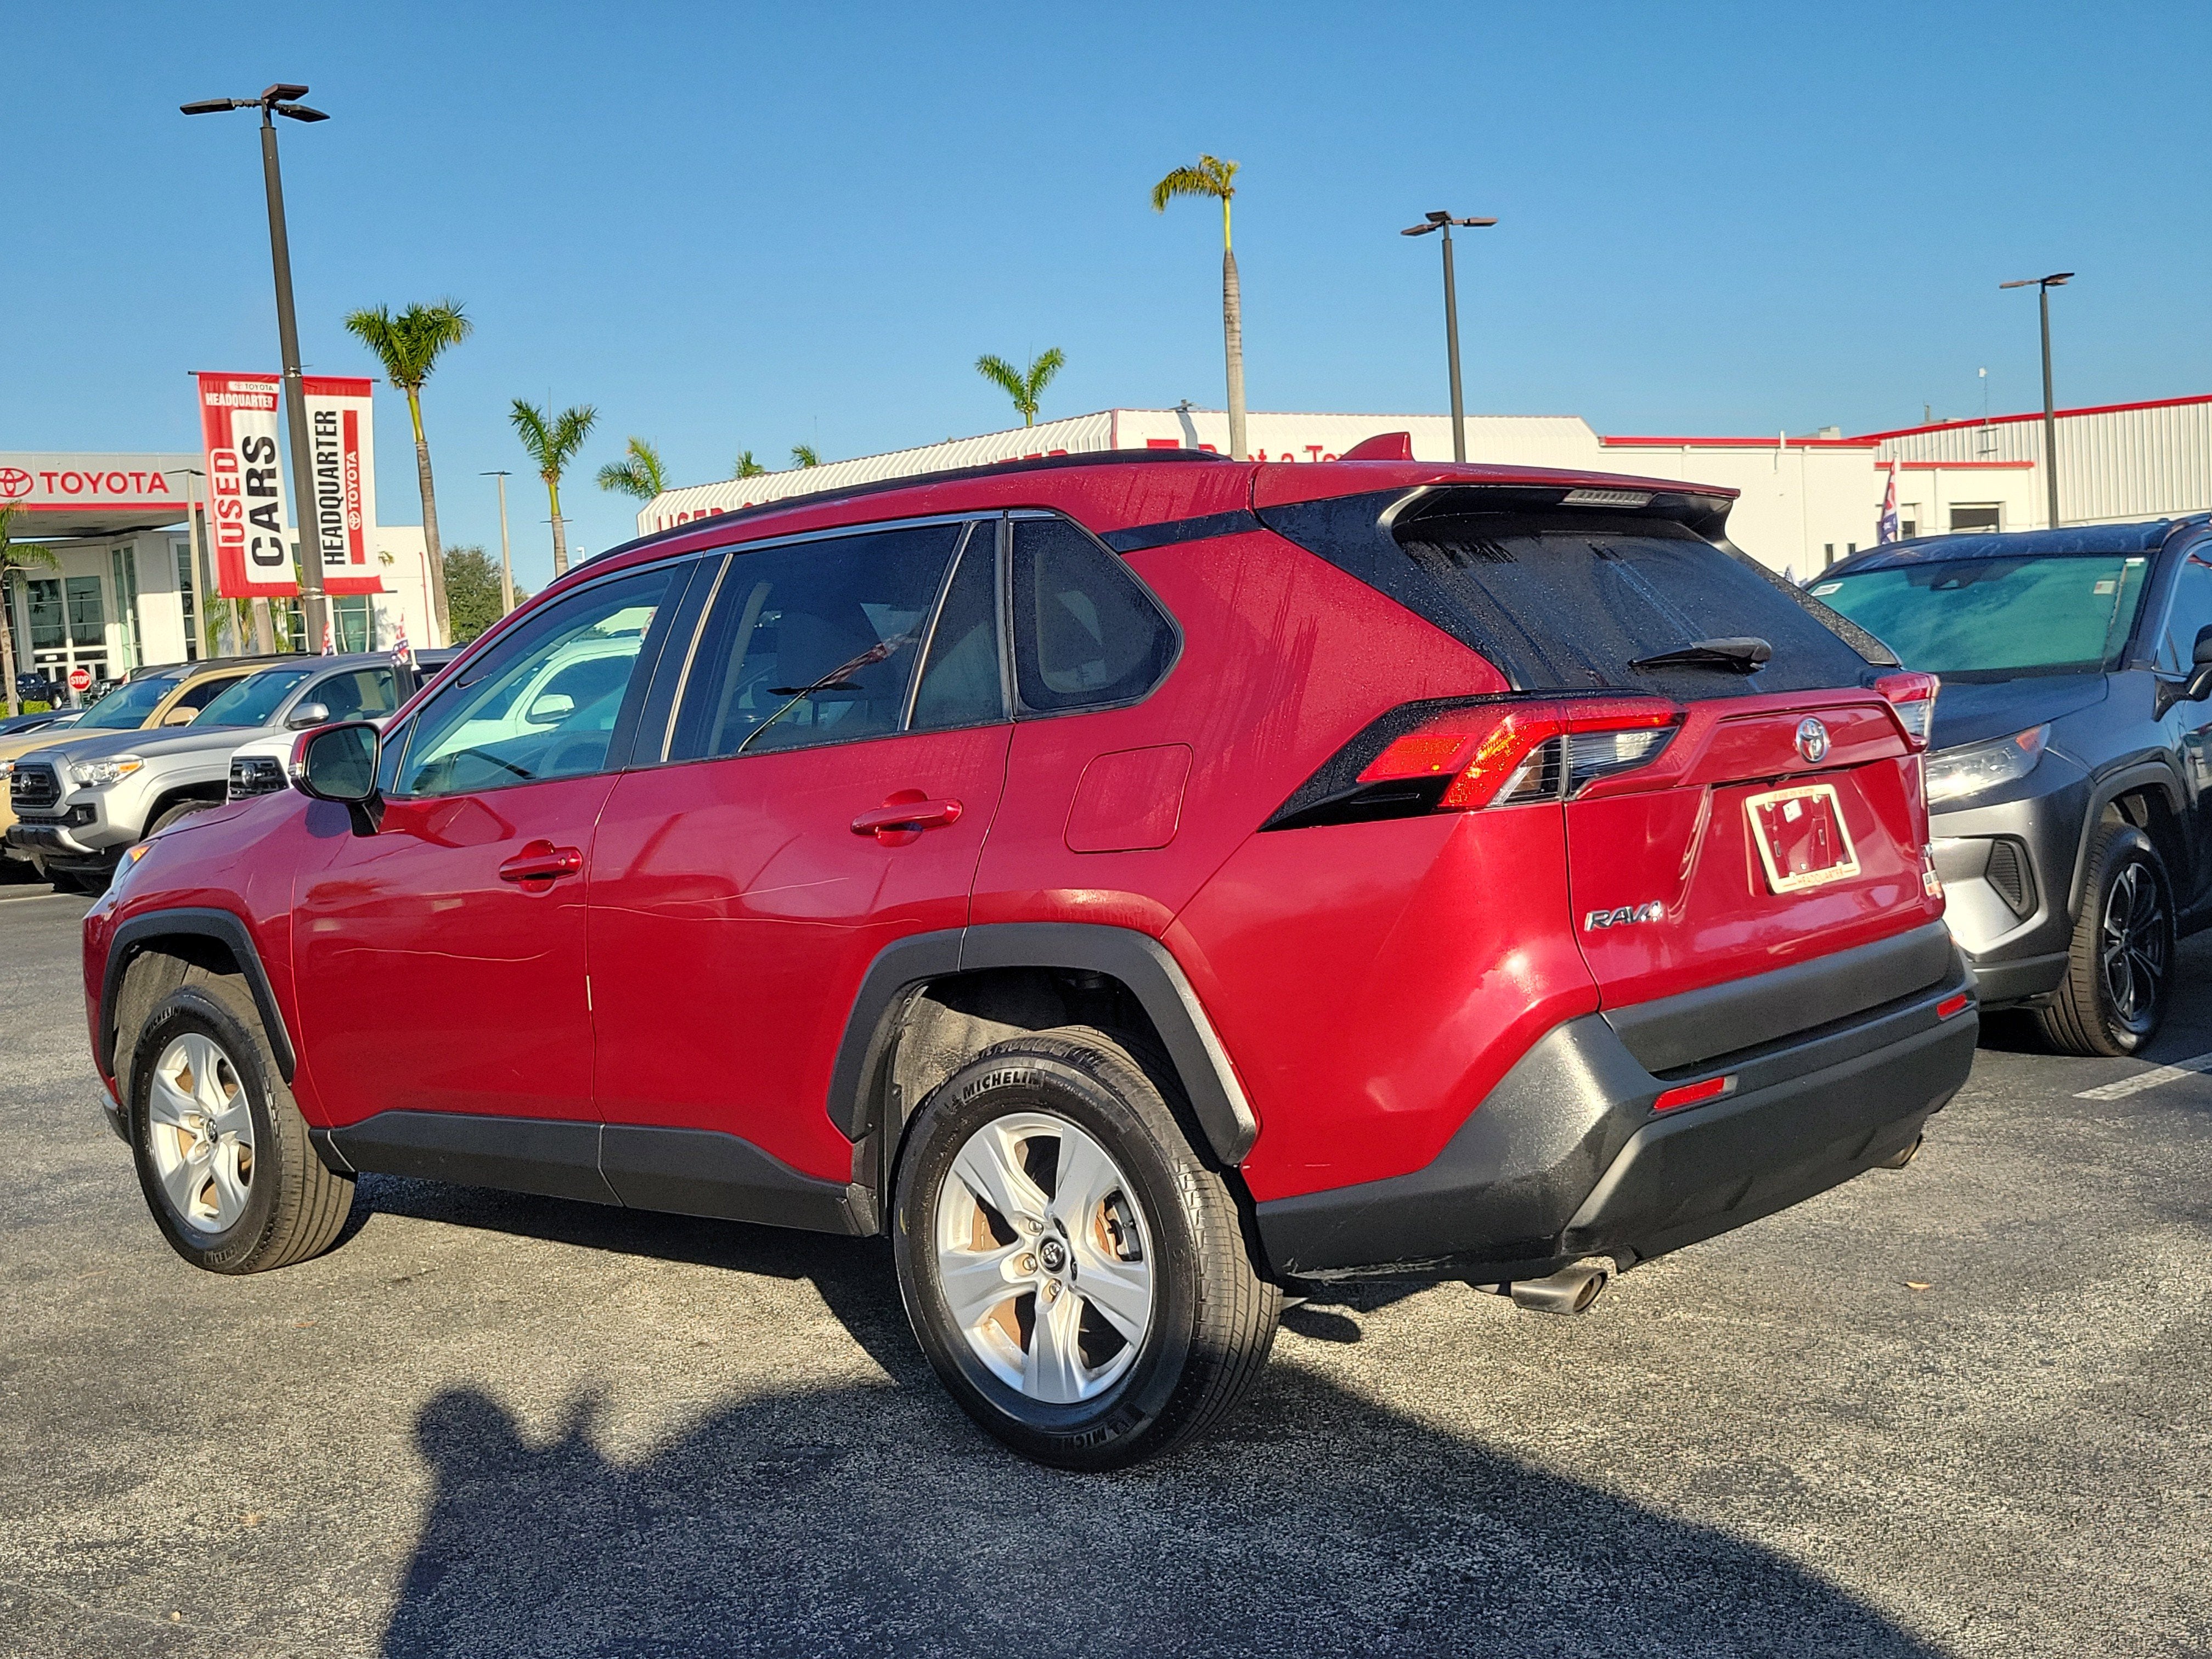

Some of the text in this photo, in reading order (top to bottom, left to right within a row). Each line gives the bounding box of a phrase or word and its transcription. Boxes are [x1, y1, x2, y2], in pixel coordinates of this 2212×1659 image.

[205, 392, 273, 408] HEADQUARTER
[39, 471, 170, 494] TOYOTA
[314, 410, 346, 565] HEADQUARTER
[346, 450, 359, 510] TOYOTA
[214, 452, 245, 544] USED
[242, 436, 284, 566] CARS
[70, 675, 89, 685] STOP
[1584, 900, 1661, 932] RAV4
[962, 1070, 1040, 1099] MICHELIN
